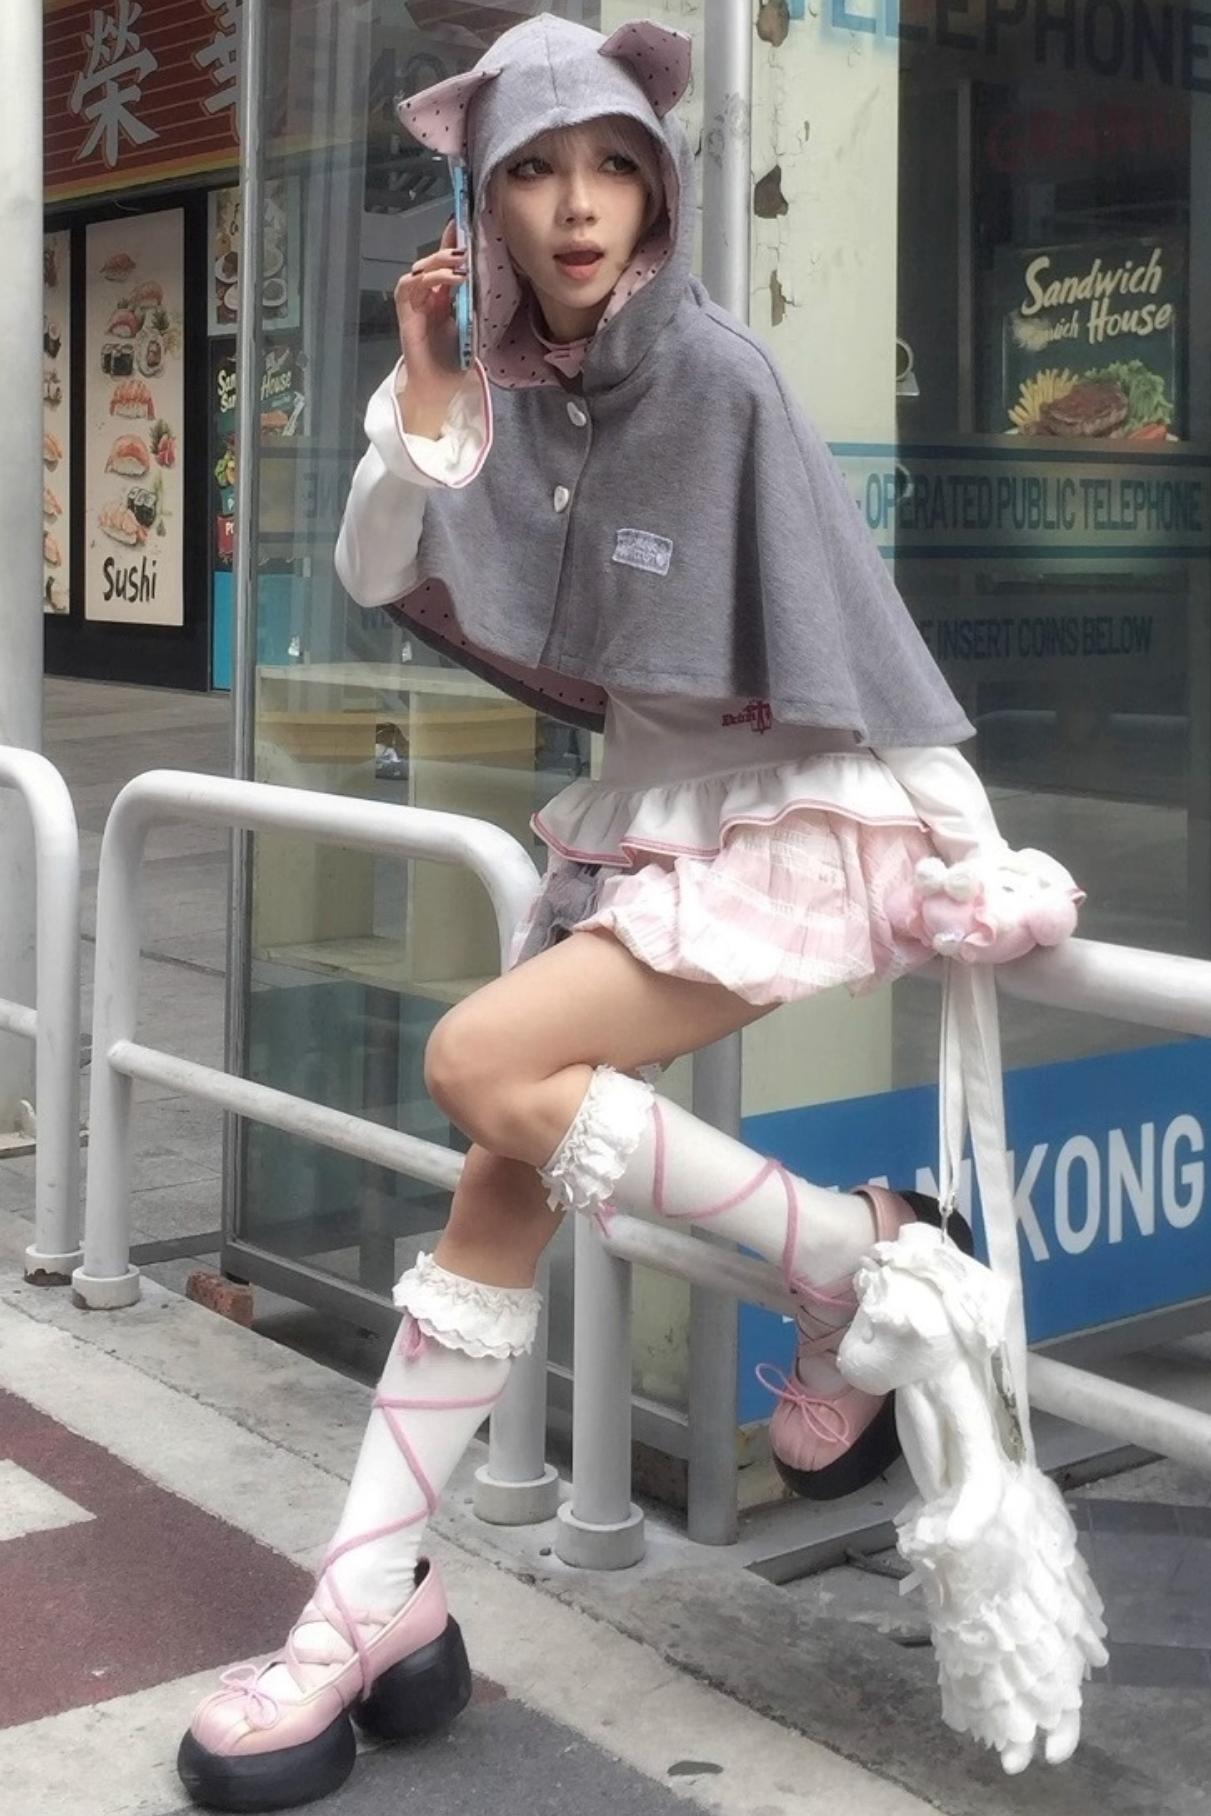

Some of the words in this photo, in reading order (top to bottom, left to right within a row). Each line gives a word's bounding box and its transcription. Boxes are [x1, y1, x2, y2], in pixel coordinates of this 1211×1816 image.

[1020, 247, 1163, 316] Sandwich
[1086, 296, 1173, 345] House
[997, 475, 1076, 531] PUBLIC
[1079, 478, 1203, 532] TELEPHONE
[103, 555, 157, 603] Sushi
[937, 617, 1015, 661] INSERT
[1018, 615, 1081, 658] COINS
[1082, 614, 1153, 656] BELOW
